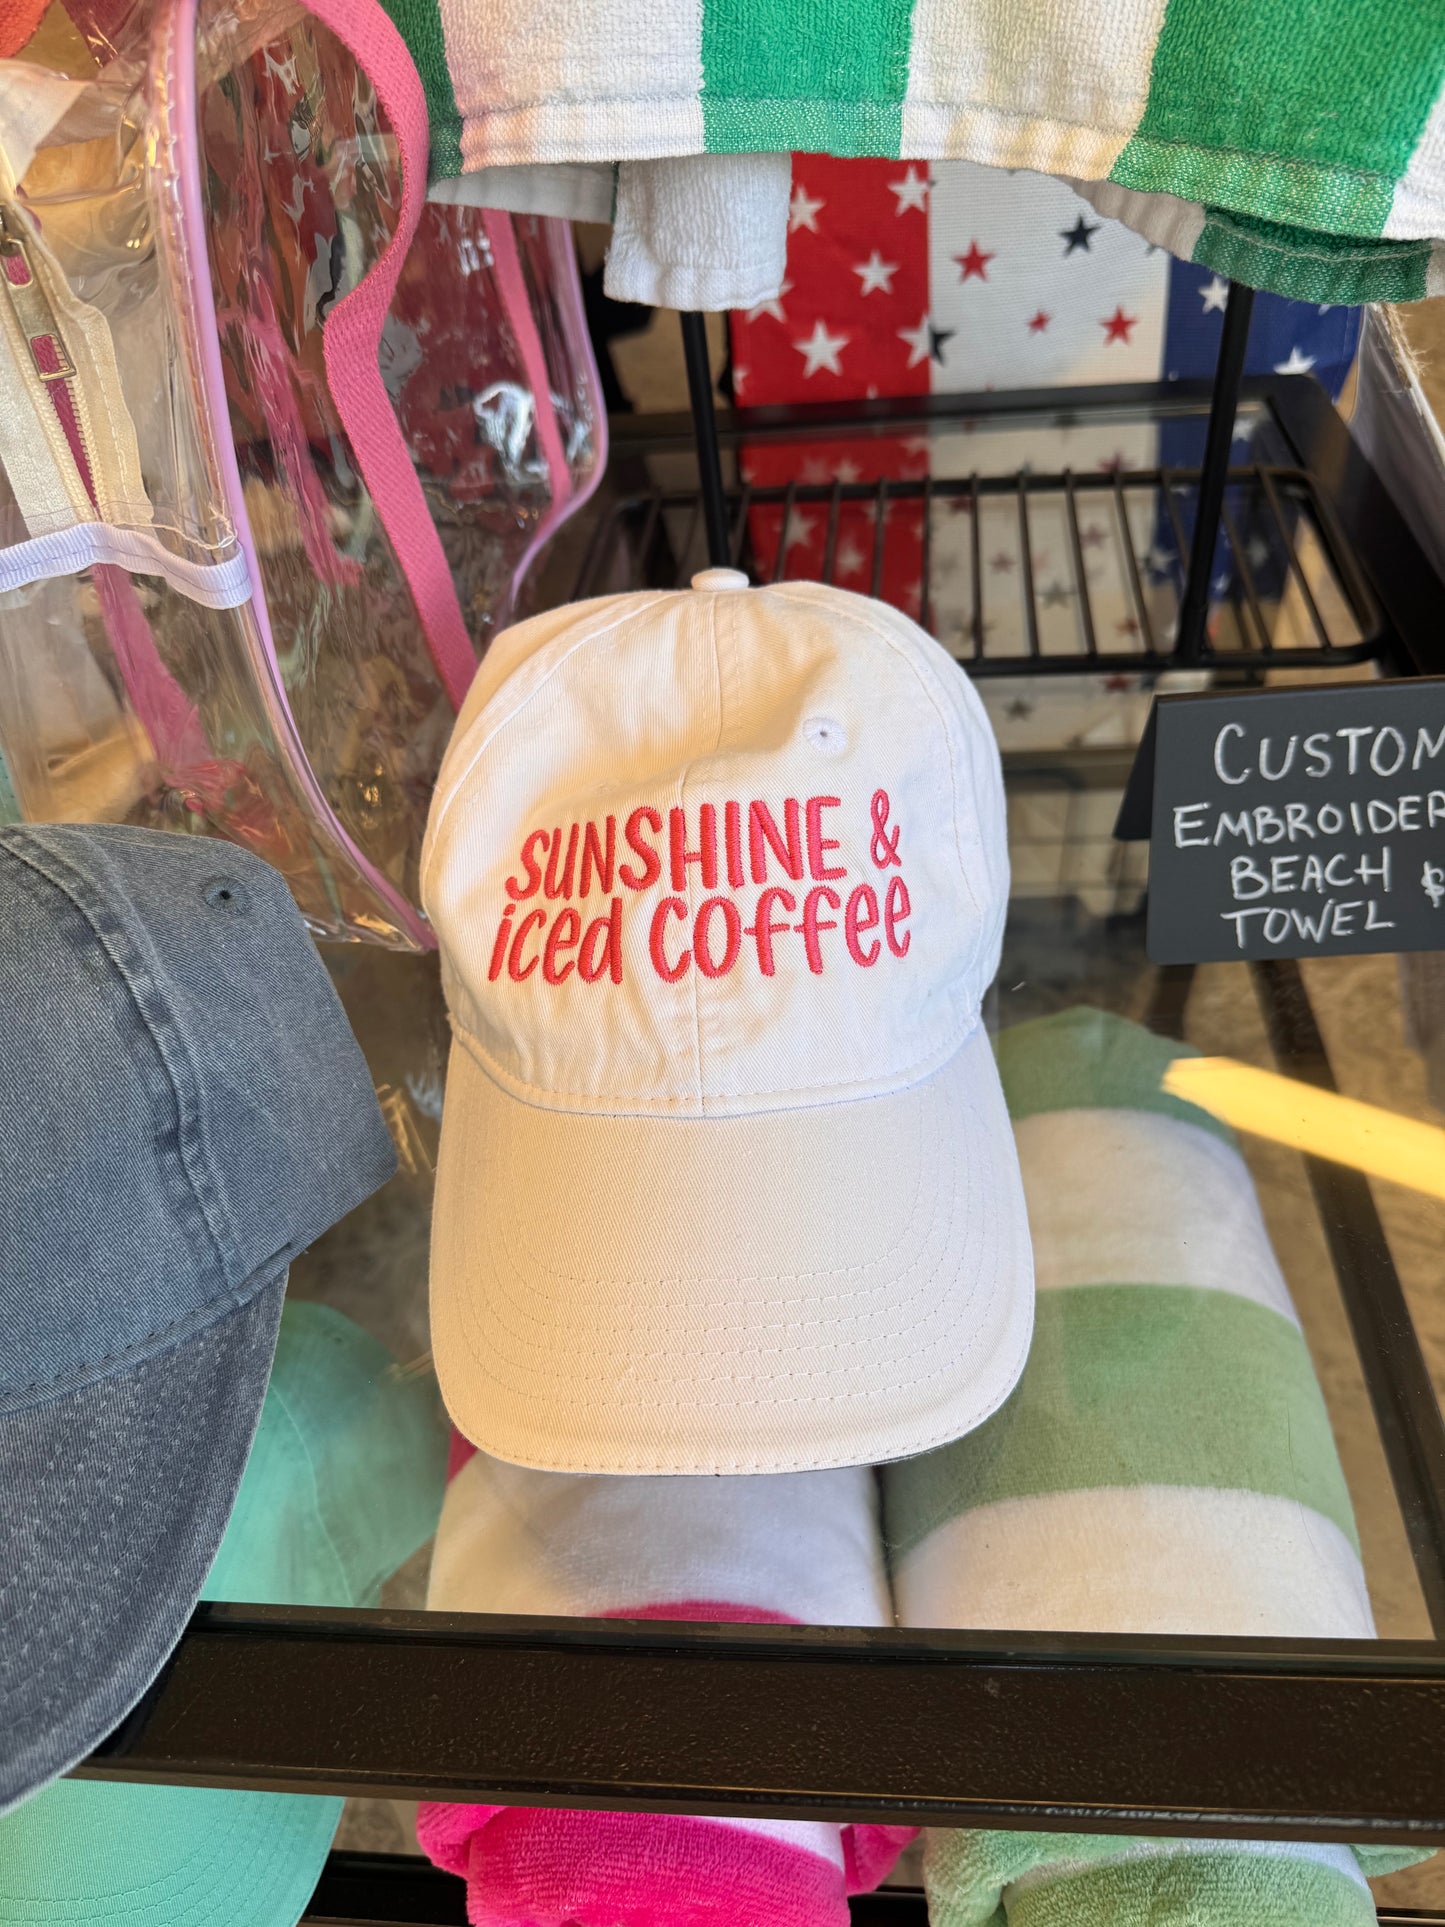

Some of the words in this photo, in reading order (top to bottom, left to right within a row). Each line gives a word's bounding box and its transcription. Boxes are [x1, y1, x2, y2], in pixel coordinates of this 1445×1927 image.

[505, 796, 847, 900] SUNSHINE
[870, 788, 901, 869] &
[1230, 846, 1392, 900] BEACH
[488, 897, 623, 985] iced
[1220, 898, 1396, 949] TOWEL
